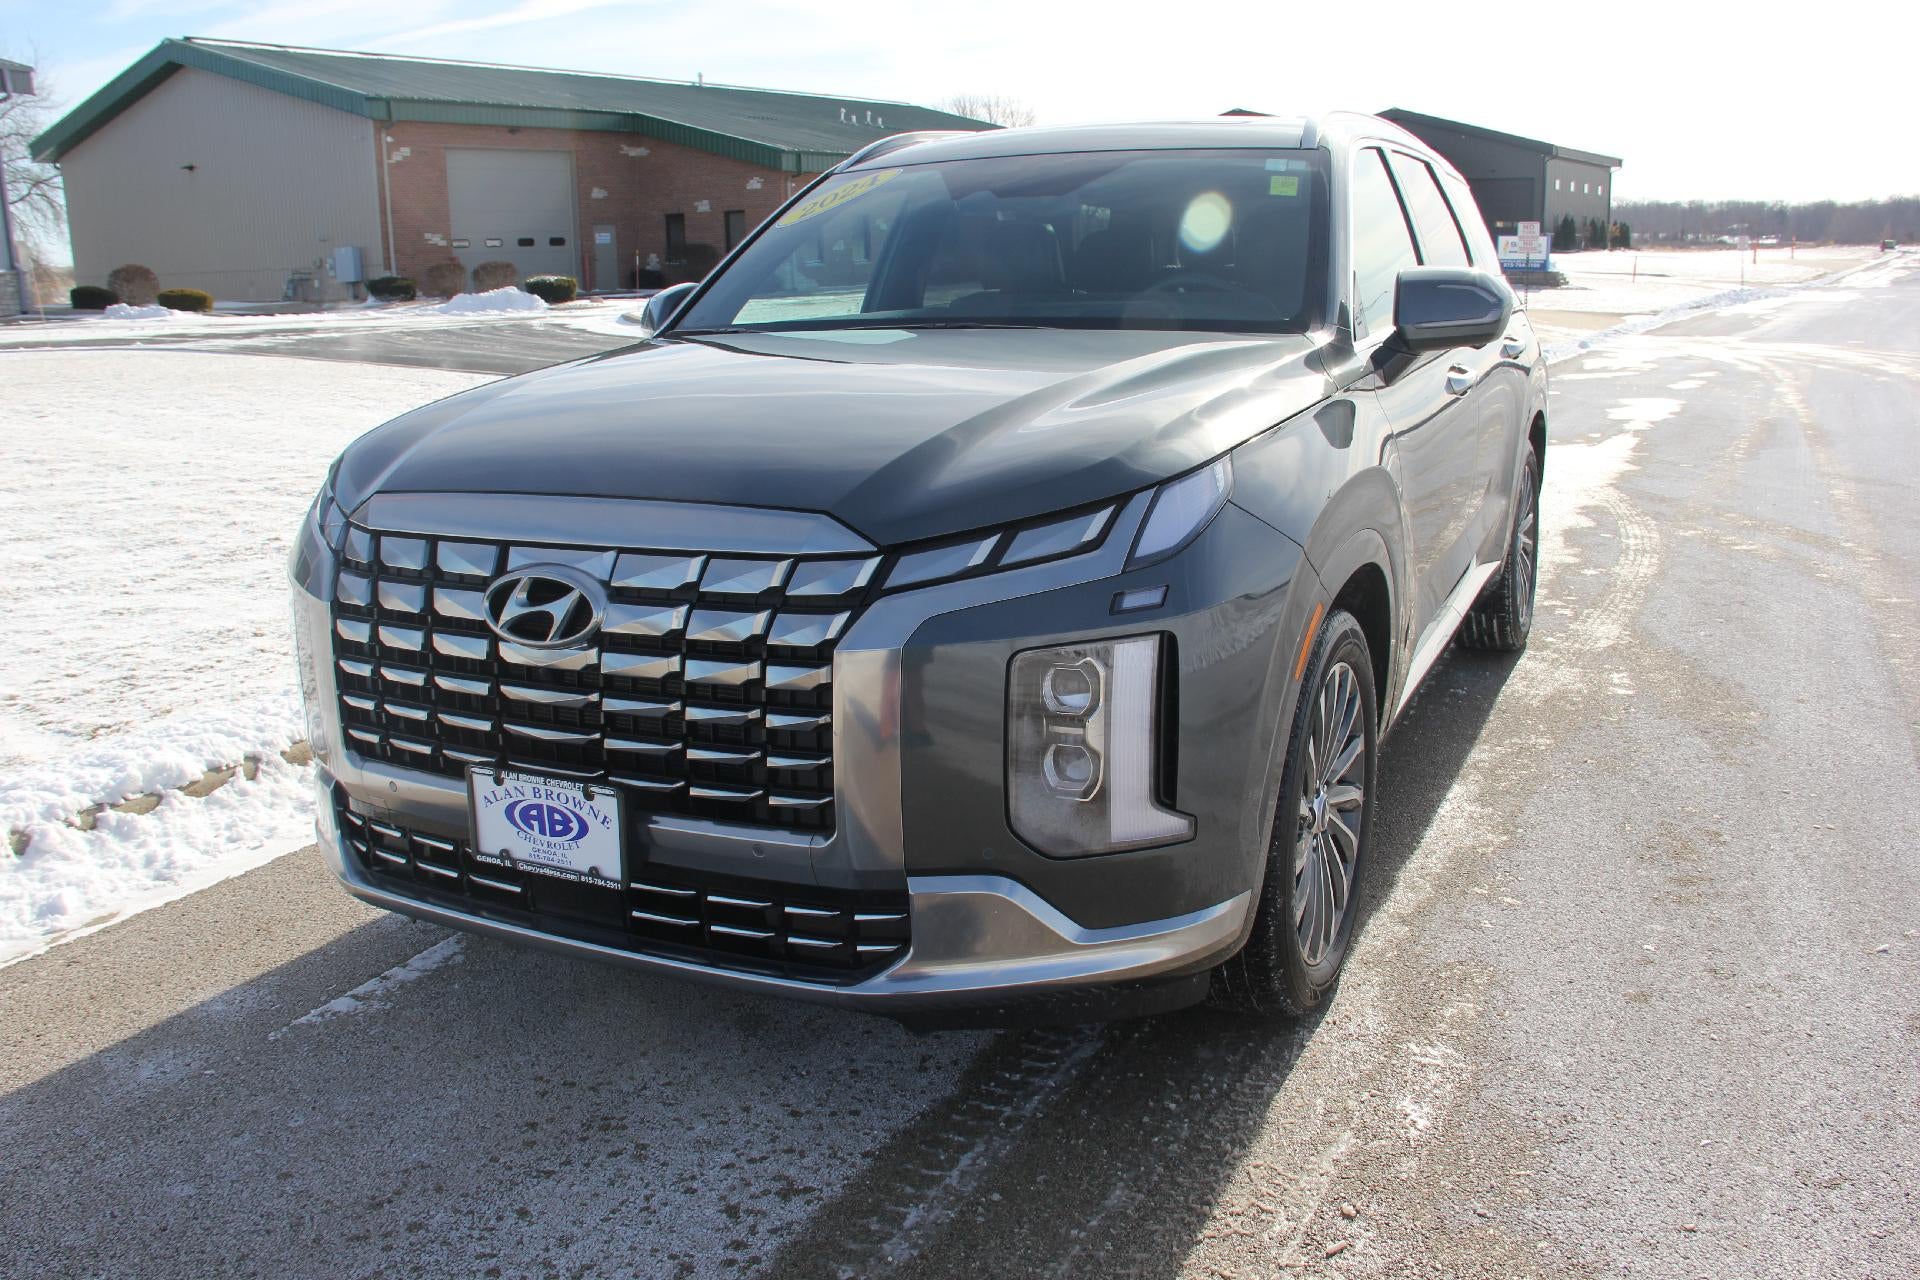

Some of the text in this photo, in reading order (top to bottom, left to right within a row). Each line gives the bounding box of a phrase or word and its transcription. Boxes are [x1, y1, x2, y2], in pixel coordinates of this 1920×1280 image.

[500, 770, 584, 792] ALAN BROWNE CHEVROLET
[483, 785, 613, 830] ALAN BROWNE
[517, 830, 580, 851] CHEVROLET
[528, 852, 572, 867] 815-784-2511
[580, 875, 621, 890] 815-784-2511
